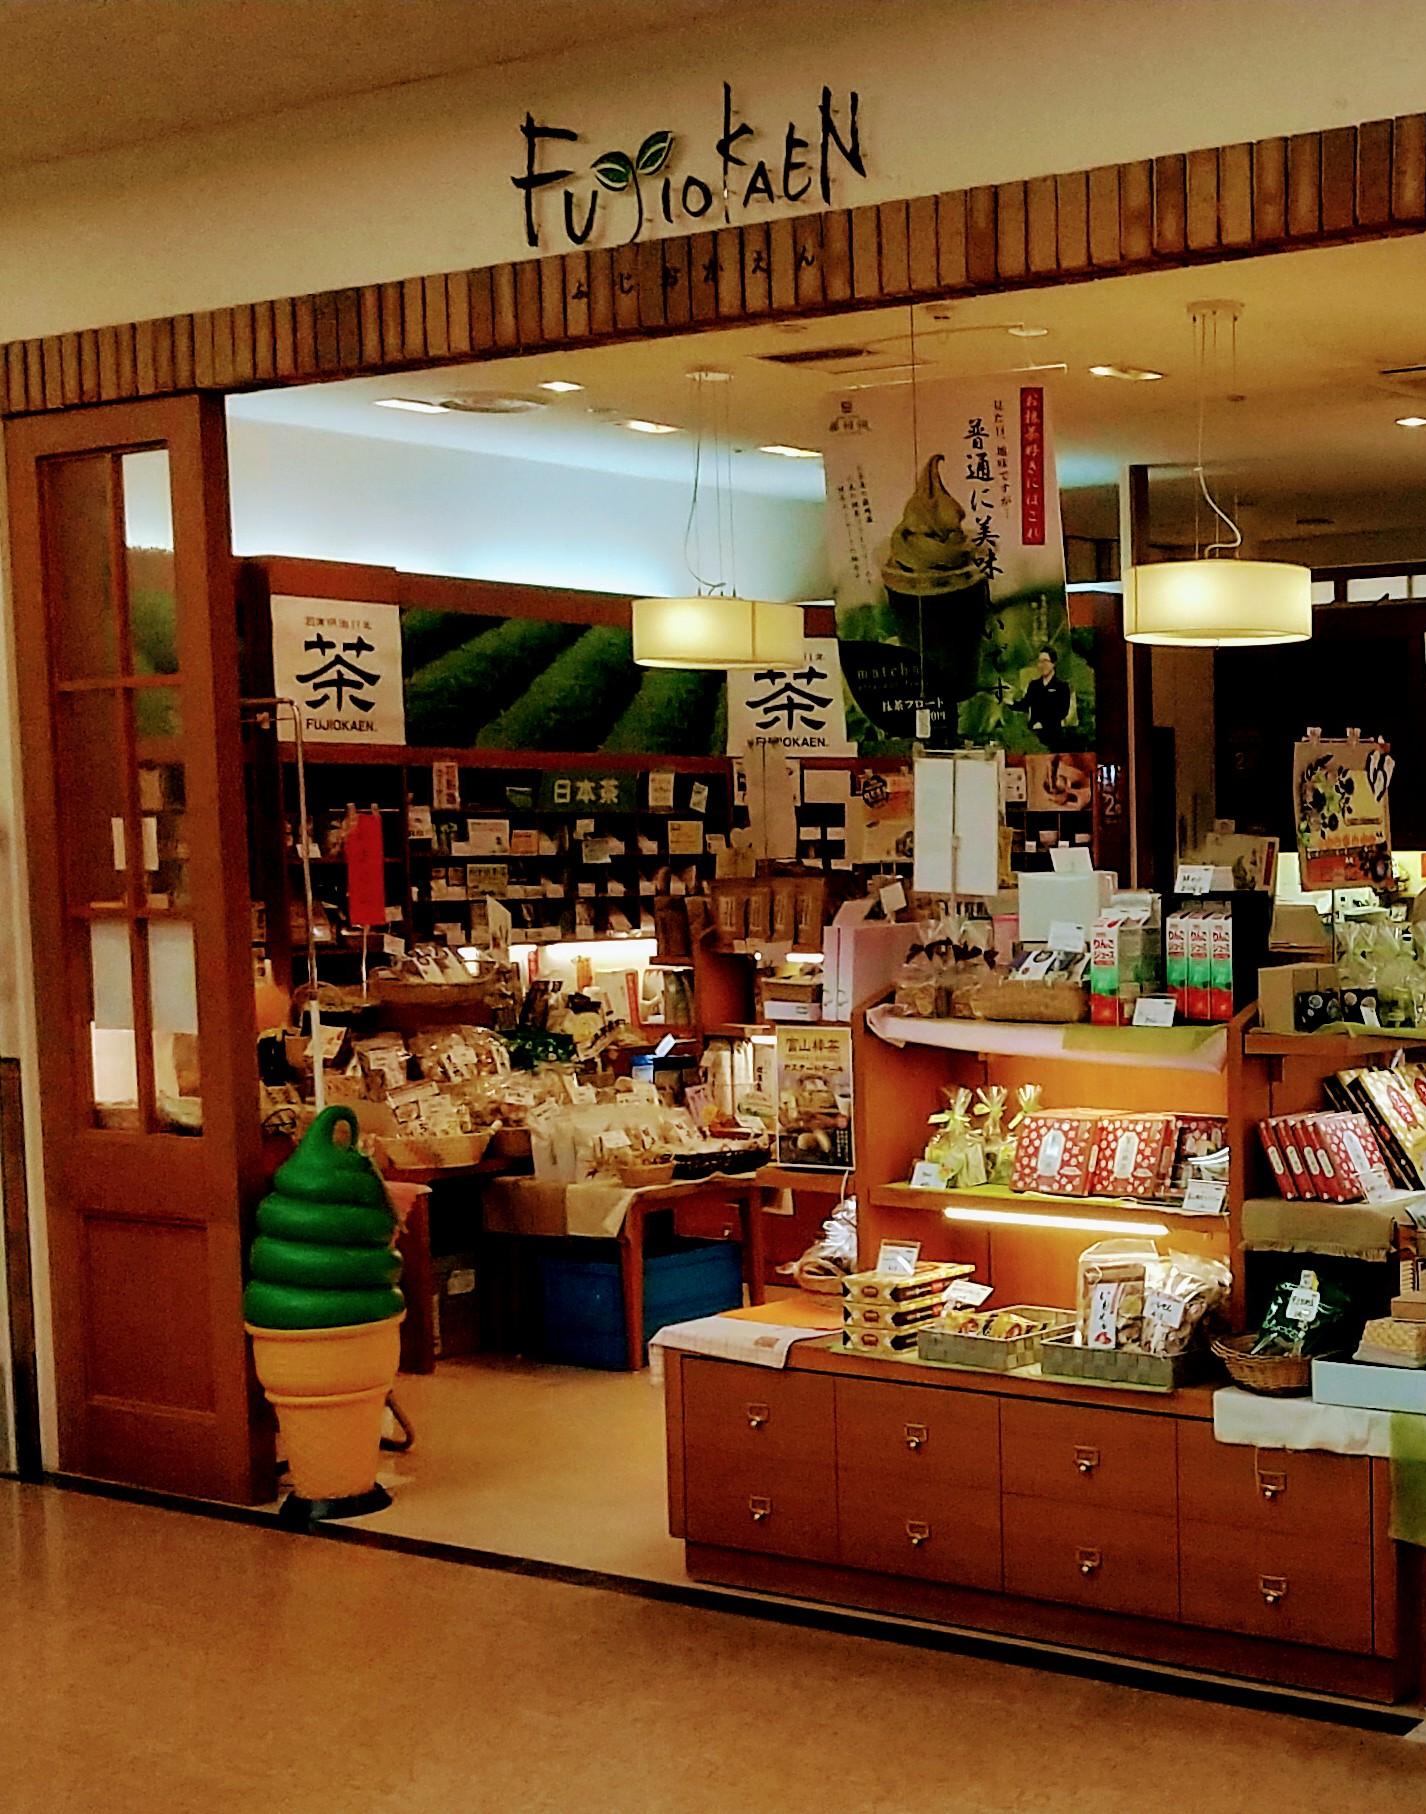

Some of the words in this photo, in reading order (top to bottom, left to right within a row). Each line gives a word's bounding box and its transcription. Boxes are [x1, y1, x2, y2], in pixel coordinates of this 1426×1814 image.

[296, 632, 381, 712] 茶
[746, 667, 833, 730] 茶
[554, 779, 620, 803] 日本茶
